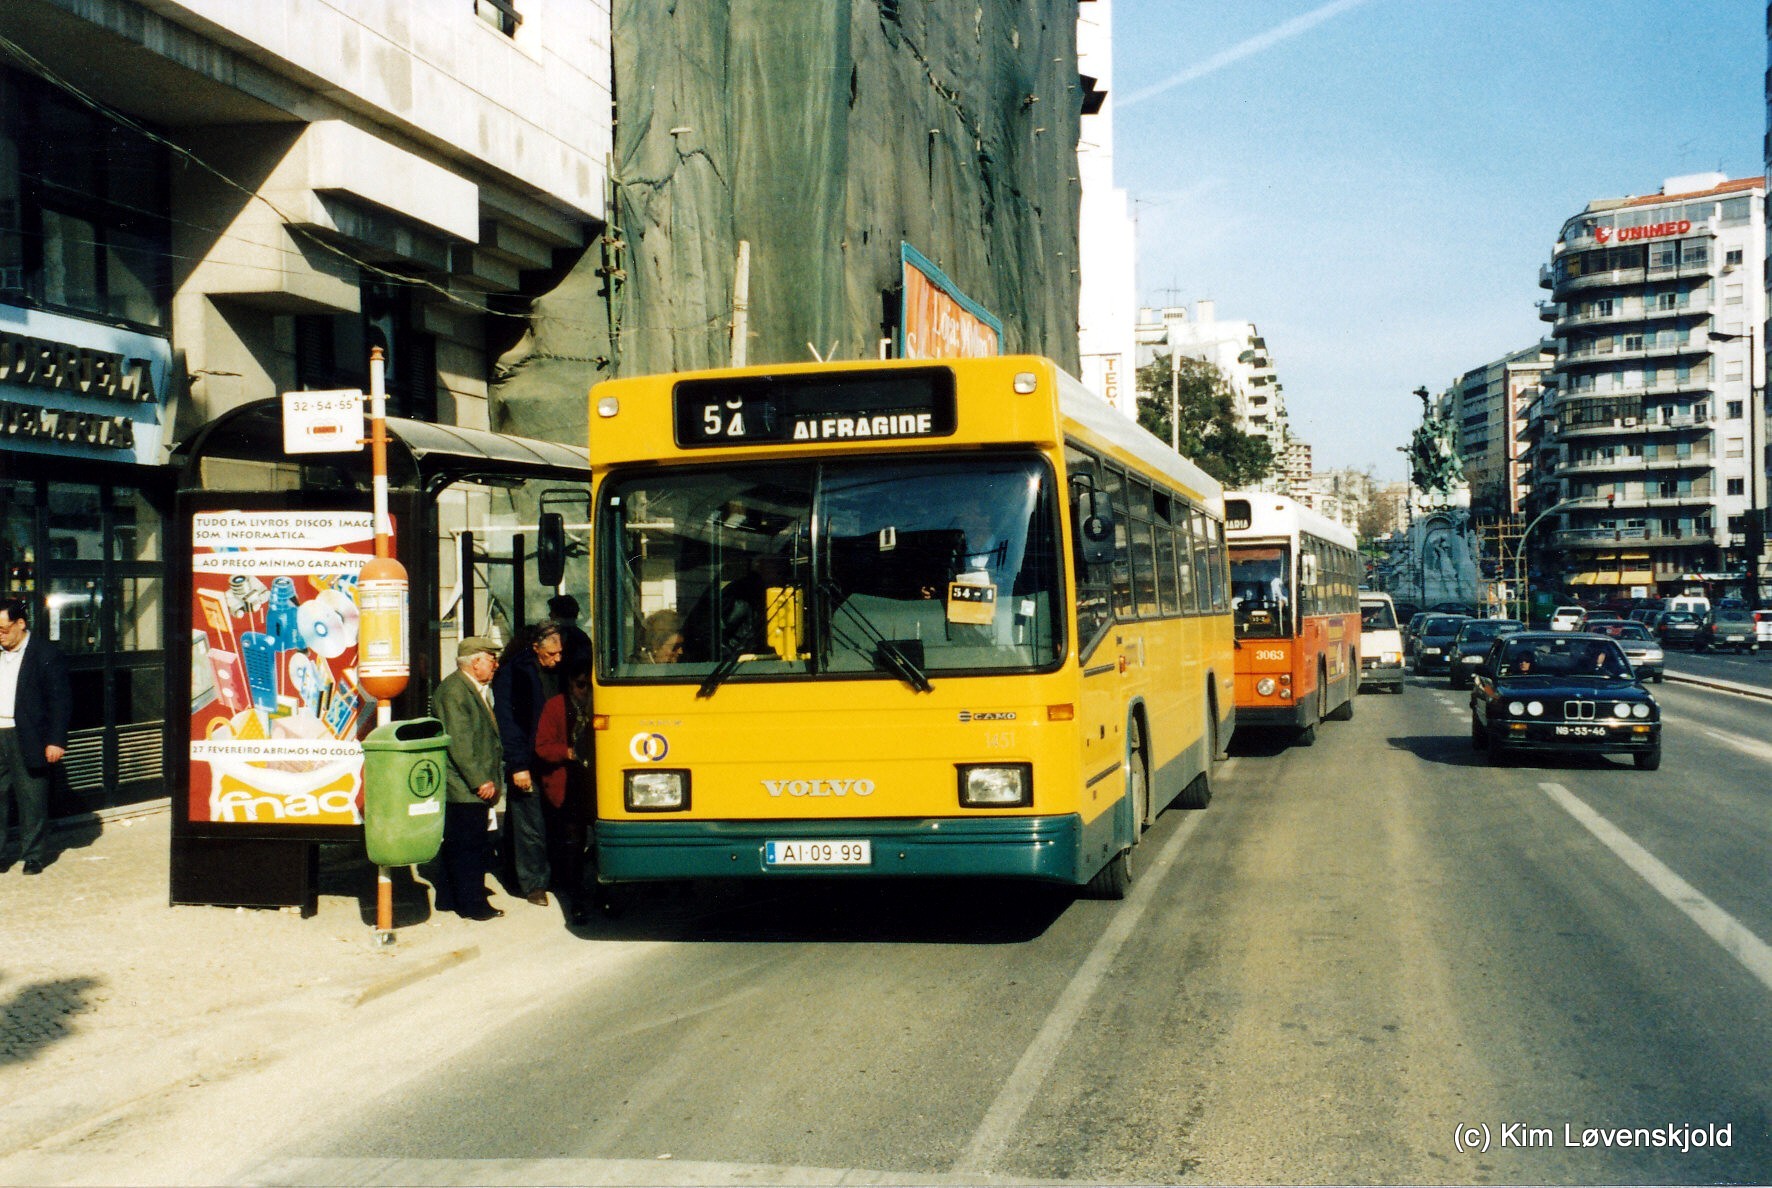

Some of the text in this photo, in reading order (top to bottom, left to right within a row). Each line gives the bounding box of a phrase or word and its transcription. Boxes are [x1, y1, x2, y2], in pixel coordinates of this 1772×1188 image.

[1617, 220, 1691, 242] UNIMED
[196, 518, 228, 527] TUDO
[231, 518, 247, 527] EM
[250, 518, 289, 527] LIVROS
[295, 518, 333, 527] DISCOS
[196, 530, 221, 539] SOM
[202, 559, 219, 567] AO
[973, 711, 1016, 721] CAMO
[192, 745, 204, 754] 27
[208, 745, 261, 755] FEVEREIRO
[263, 747, 310, 755] ABRIMOS
[312, 747, 328, 756] NO
[763, 778, 875, 797] VOLVO
[217, 790, 353, 822] fnac
